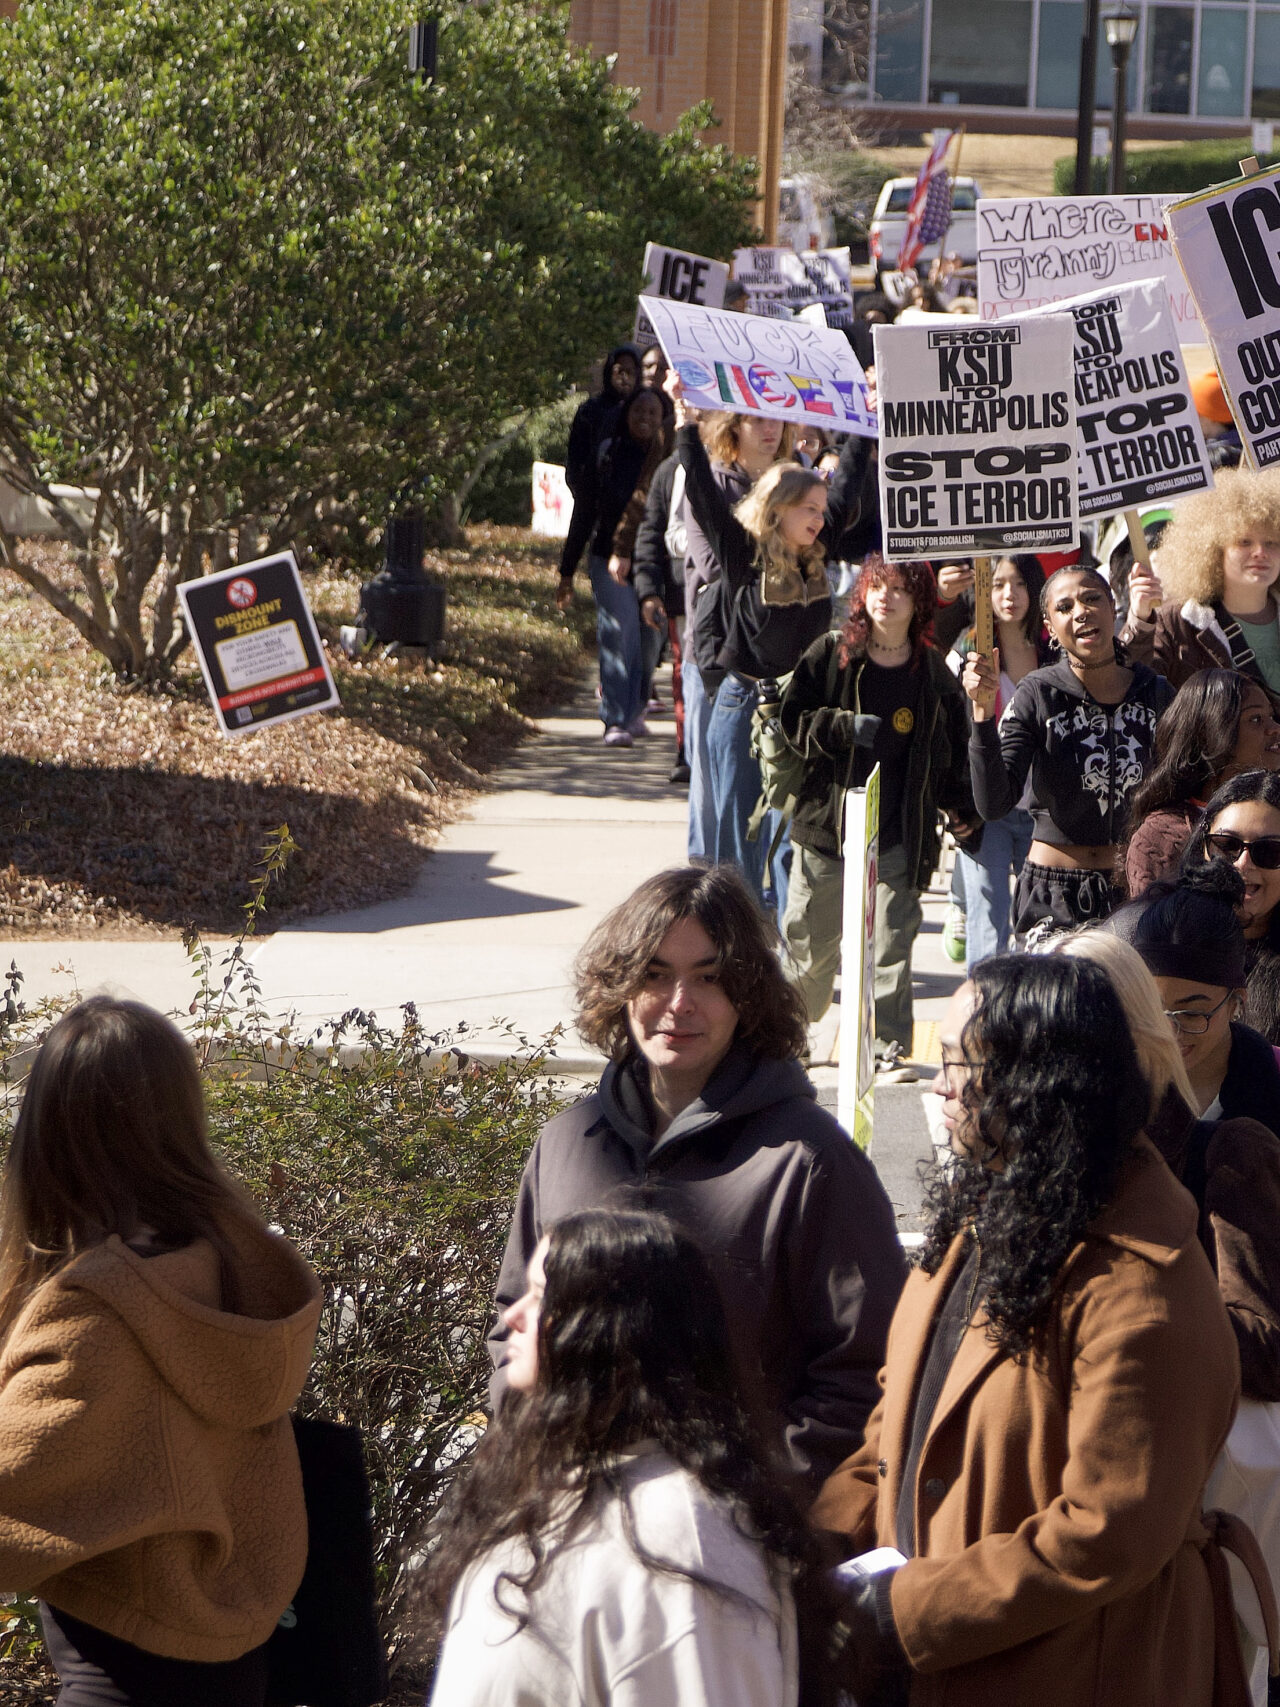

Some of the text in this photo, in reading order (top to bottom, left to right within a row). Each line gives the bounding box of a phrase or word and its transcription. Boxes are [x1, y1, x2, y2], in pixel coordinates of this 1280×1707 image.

[981, 198, 1166, 243] Where TH
[1134, 222, 1169, 241] EN
[658, 252, 710, 306] ICE
[978, 241, 1116, 299] Tyranny
[1117, 239, 1174, 265] BEGIN
[1072, 300, 1118, 320] OM
[660, 302, 841, 379] FUCK
[932, 329, 1016, 346] FROM
[1074, 313, 1123, 360] SU
[938, 344, 1012, 392] KSU
[1078, 354, 1112, 371] TO
[956, 386, 997, 400] TO
[884, 391, 1069, 438] MINNEAPOLIS
[1077, 393, 1188, 443] TOP
[885, 443, 1071, 481] STOP
[1086, 424, 1201, 486] TERROR
[887, 477, 1071, 529] ICE TERROR
[1080, 497, 1092, 509] FOR
[1092, 492, 1123, 507] SOCIALISM
[890, 528, 1070, 547] STUDENTS FOR SOCIALISM @SOCIALISMATKSU
[215, 598, 282, 629] DISMOUNT
[236, 615, 270, 633] ZONE
